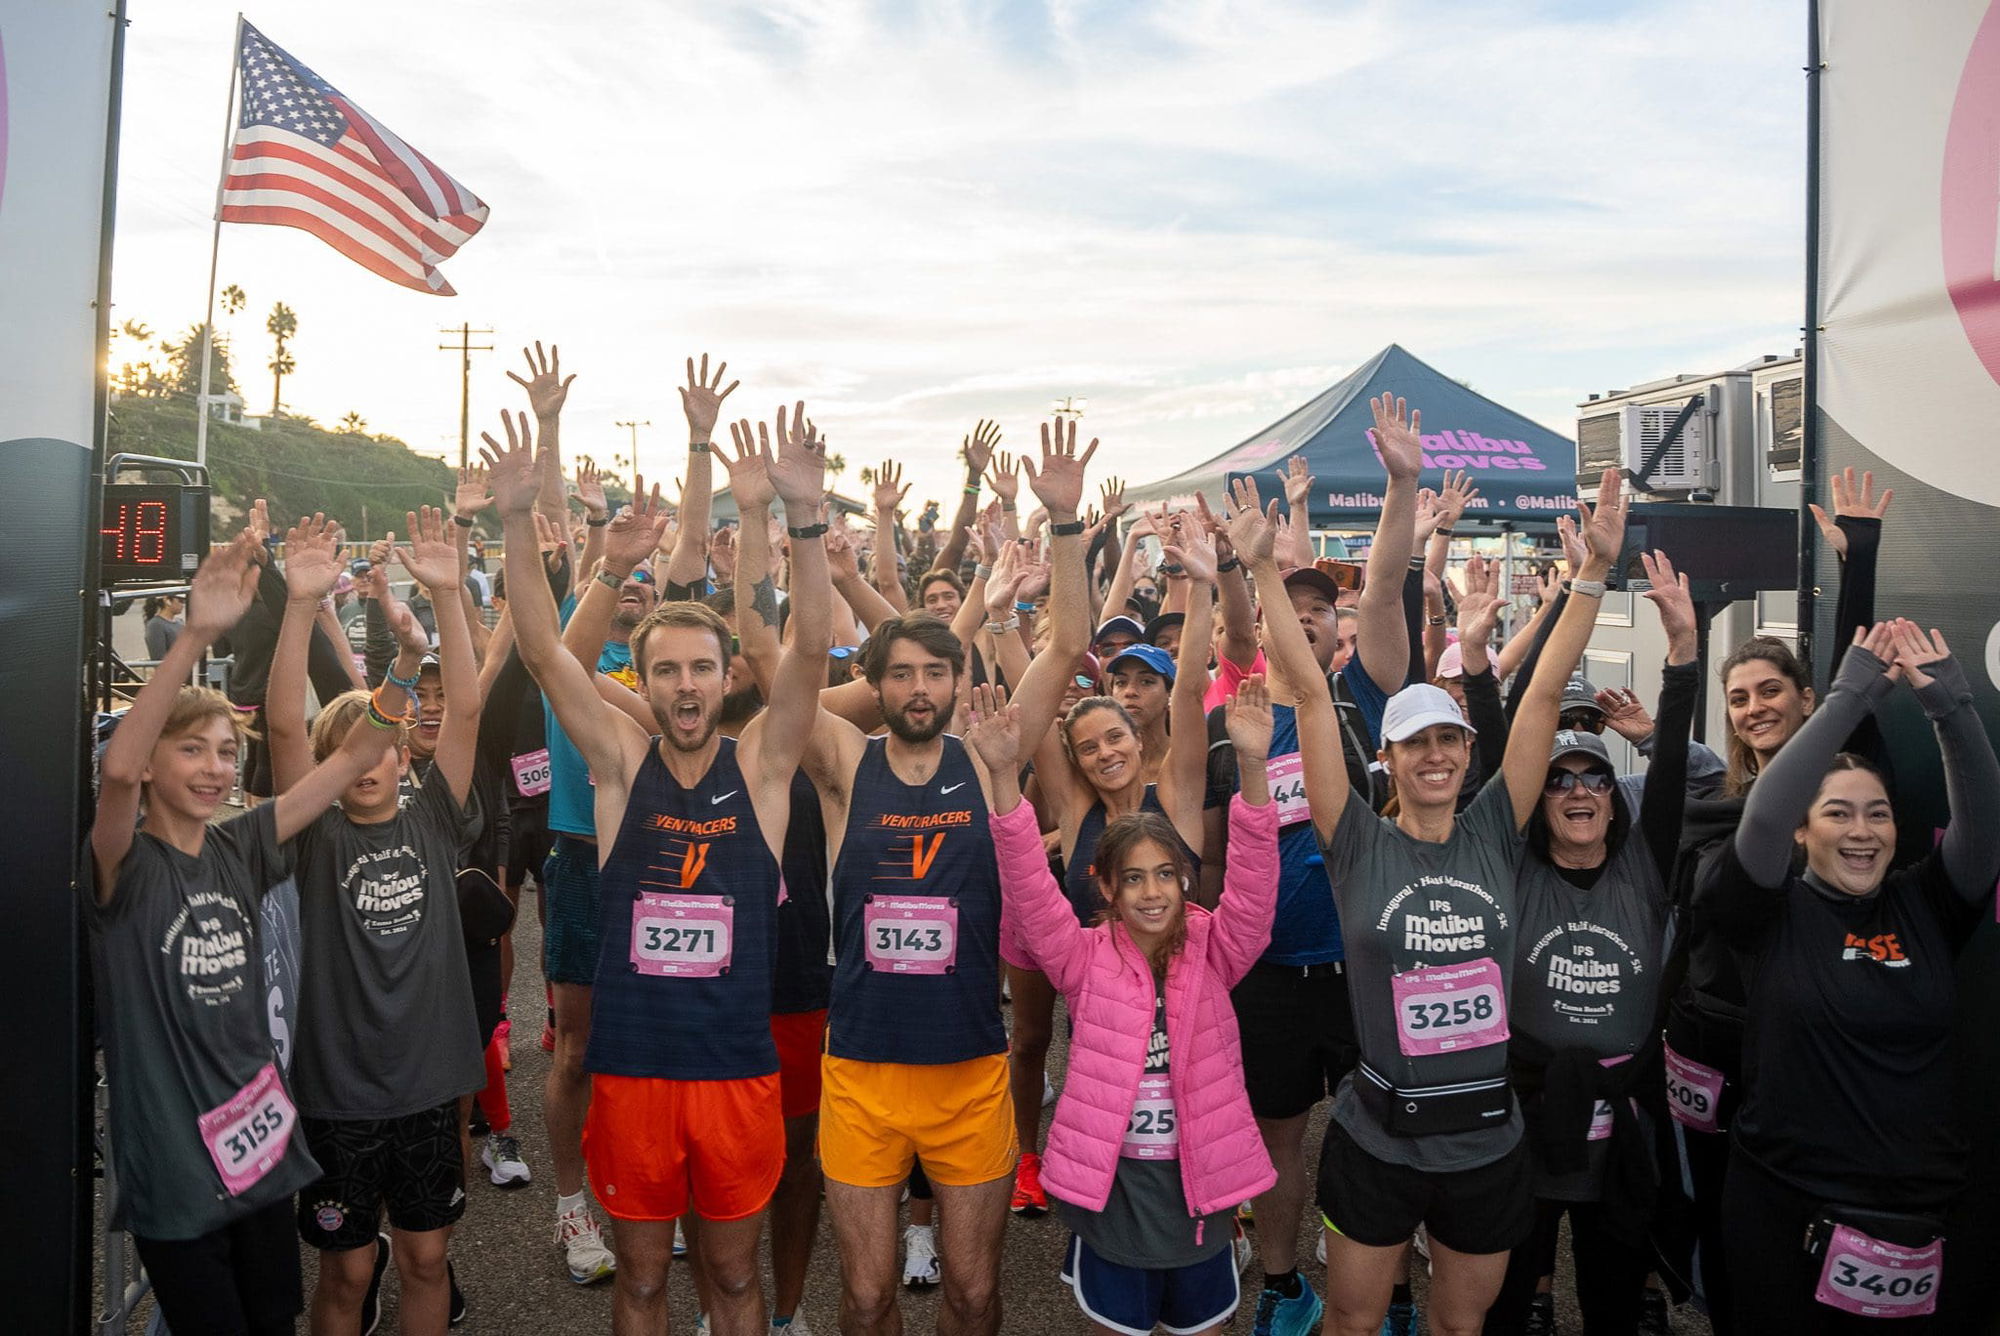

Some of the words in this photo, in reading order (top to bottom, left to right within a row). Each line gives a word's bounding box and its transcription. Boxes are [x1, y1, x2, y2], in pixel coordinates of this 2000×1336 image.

[1365, 429, 1534, 455] alibu
[1515, 494, 1578, 510] @Malib
[520, 765, 550, 786] 306
[1273, 779, 1308, 804] 44
[1376, 885, 1415, 932] Inaugural
[1429, 899, 1452, 912] IPS
[644, 926, 715, 954] 3271
[875, 927, 943, 952] 3143
[1572, 944, 1596, 957] IPS
[1407, 993, 1494, 1030] 3258
[1667, 1079, 1709, 1114] 409
[223, 1101, 284, 1165] 3155
[1833, 1259, 1935, 1298] 3406
